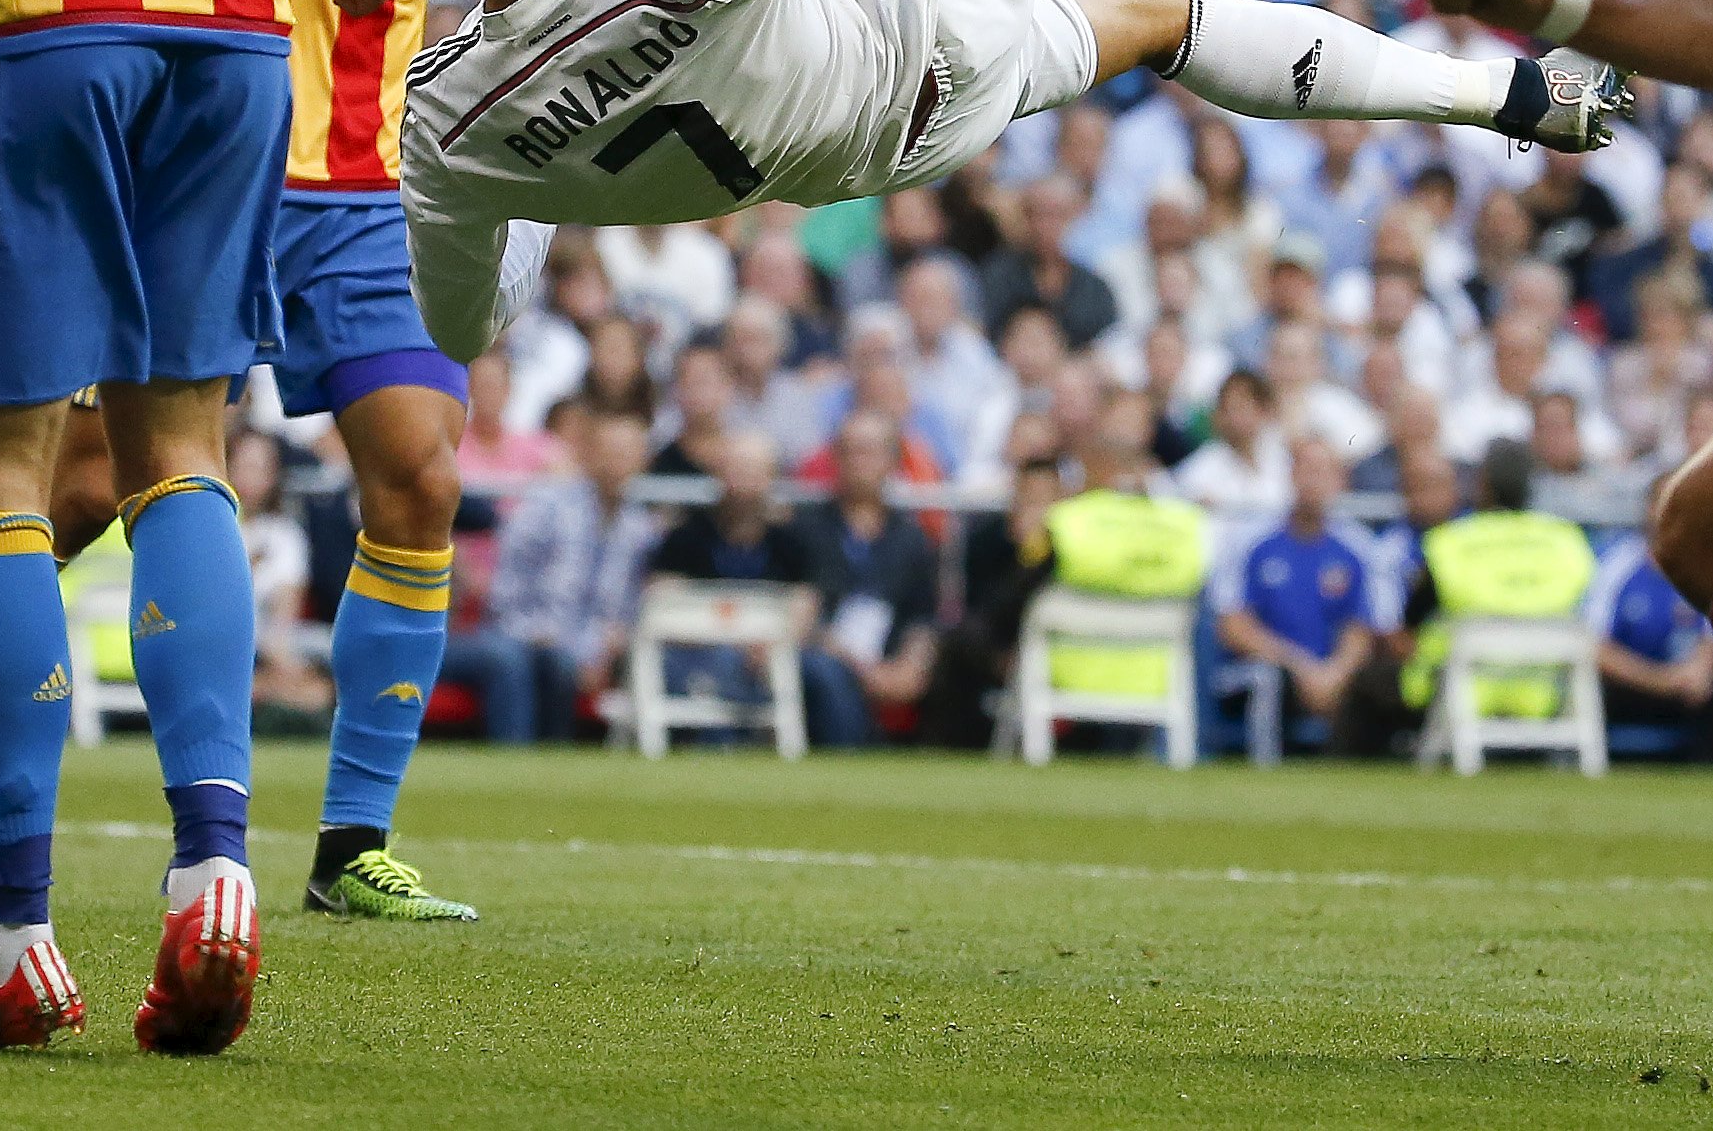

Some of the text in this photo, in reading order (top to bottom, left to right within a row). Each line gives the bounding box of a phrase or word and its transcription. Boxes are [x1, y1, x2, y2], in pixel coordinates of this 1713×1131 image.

[502, 18, 699, 168] RONALDO
[1297, 38, 1323, 111] adidas
[590, 99, 766, 203] 7
